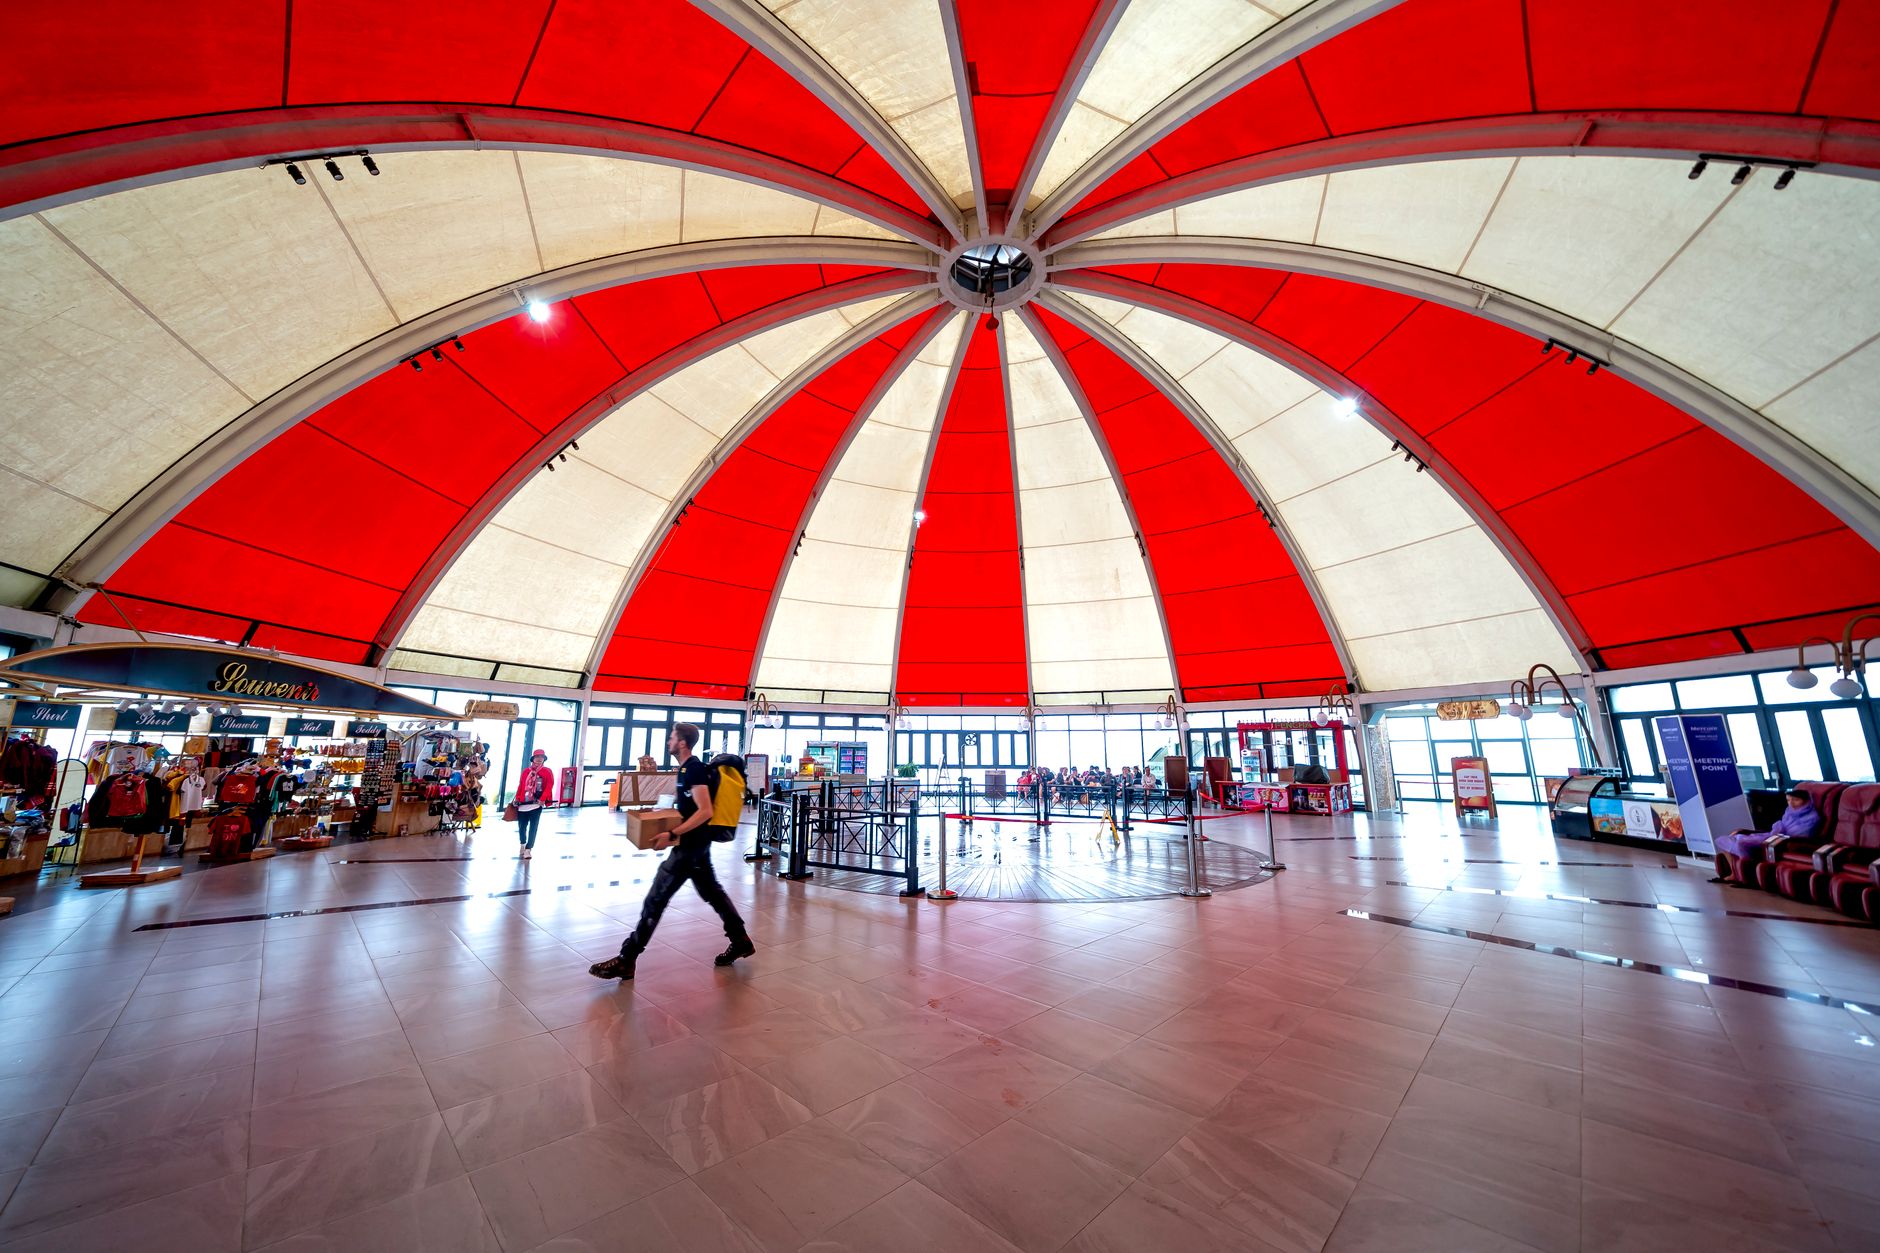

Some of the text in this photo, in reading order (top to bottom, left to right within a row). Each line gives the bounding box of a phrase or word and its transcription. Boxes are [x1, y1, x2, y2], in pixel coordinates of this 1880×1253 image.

[214, 662, 320, 702] Souvenir
[32, 706, 69, 721] Shirt
[135, 713, 176, 726] Shirt
[299, 721, 322, 732] Hat
[354, 725, 382, 736] Teddy
